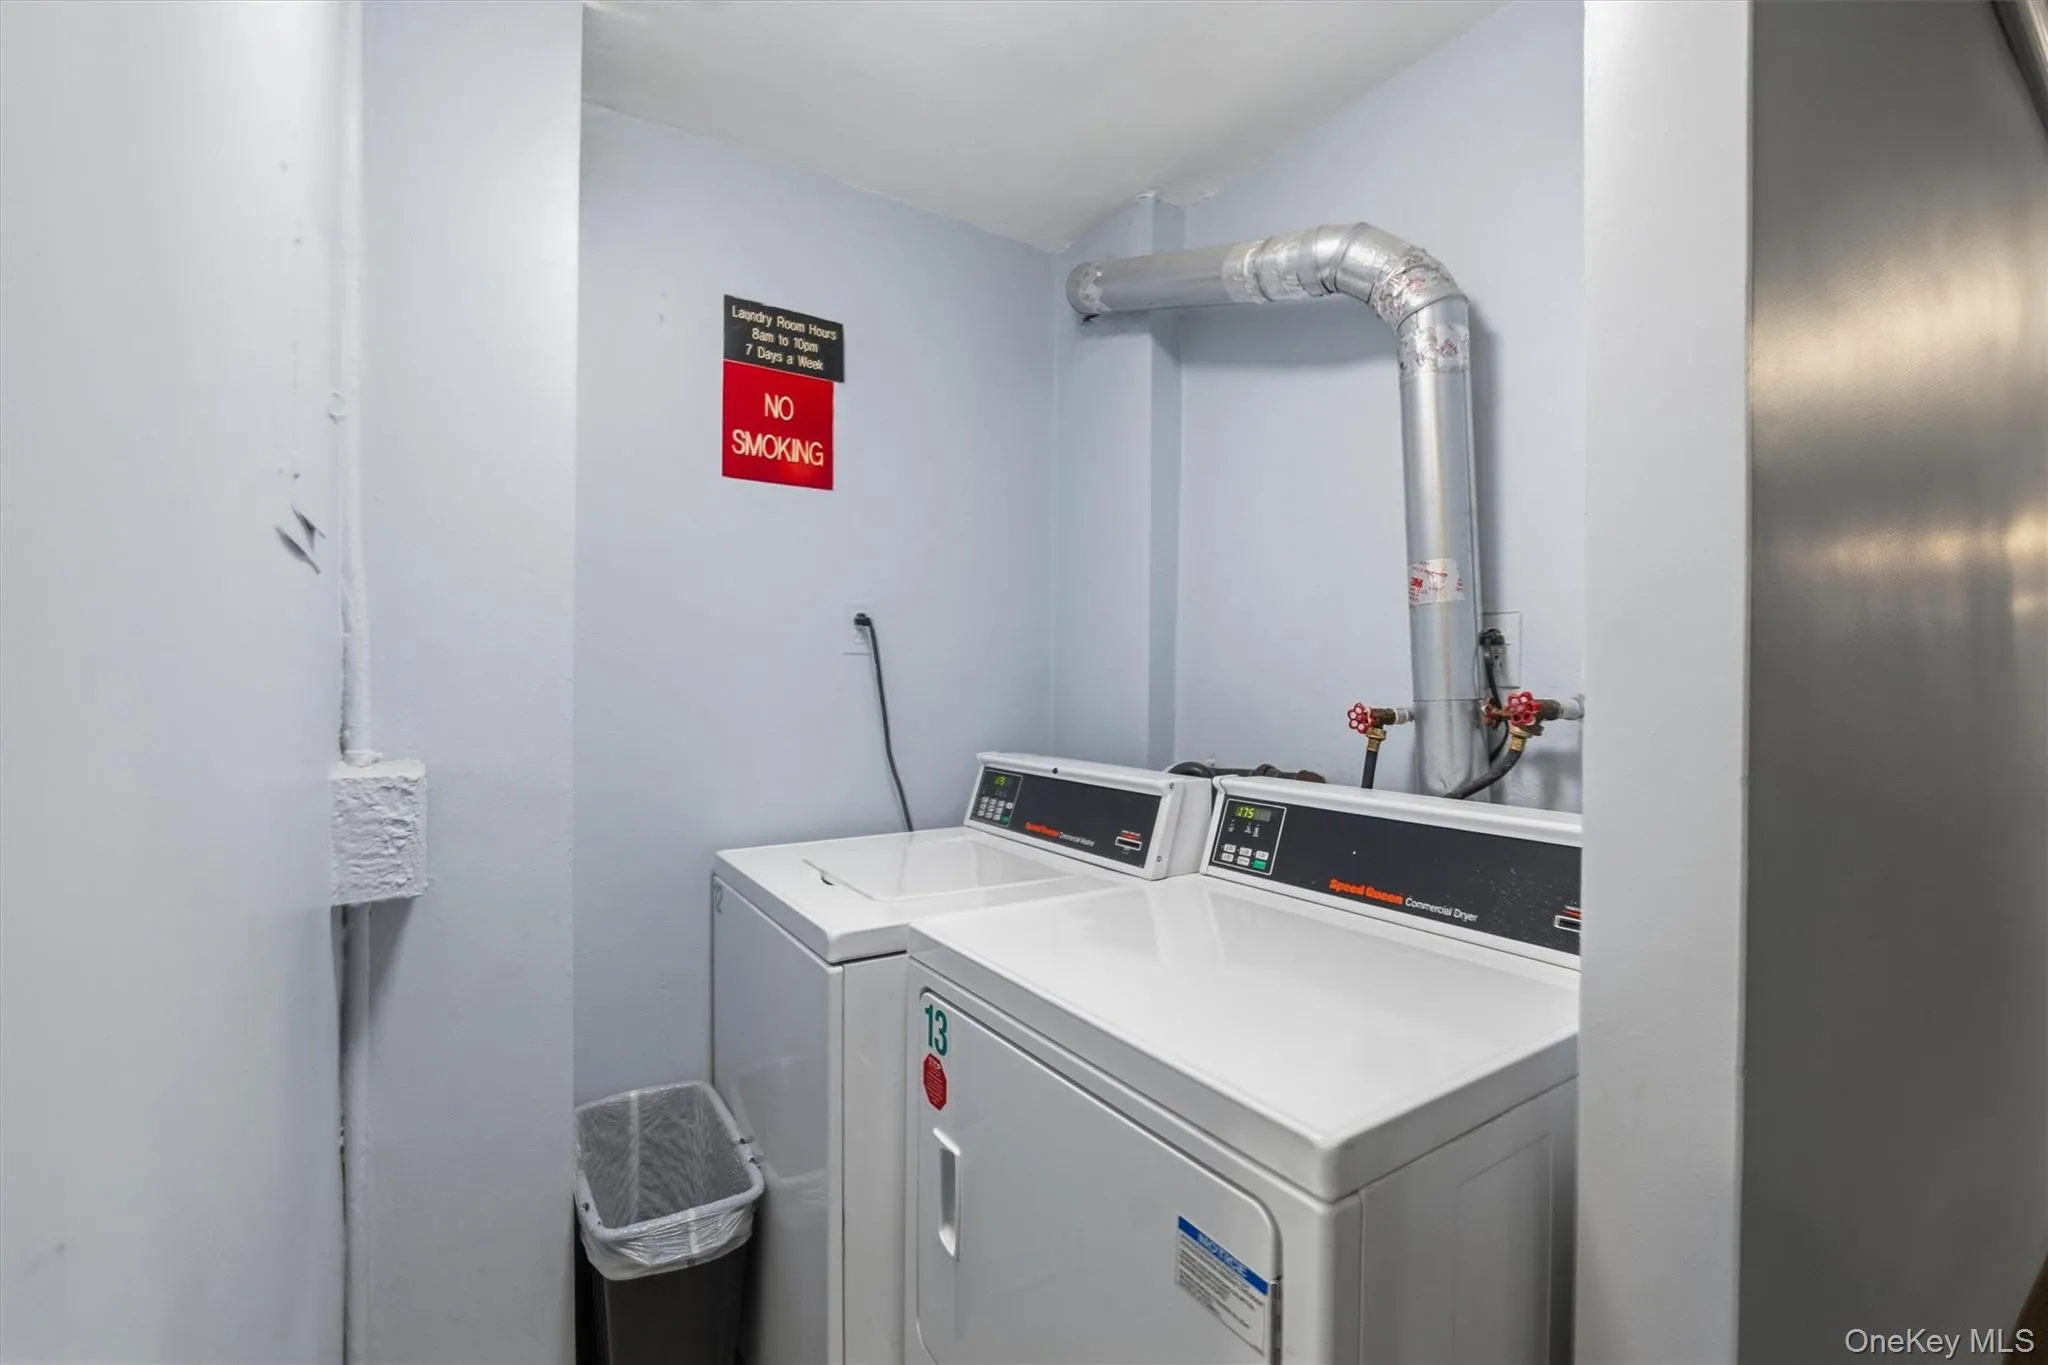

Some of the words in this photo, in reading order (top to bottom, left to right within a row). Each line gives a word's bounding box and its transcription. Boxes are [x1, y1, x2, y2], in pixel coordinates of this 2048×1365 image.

[732, 305, 772, 328] Laundry
[777, 316, 805, 333] Room
[809, 324, 837, 341] Hours
[752, 328, 774, 343] 8am
[778, 335, 789, 347] to
[794, 337, 818, 353] 10pm
[745, 343, 753, 355] 7
[757, 347, 783, 363] Days
[786, 354, 794, 365] a
[798, 355, 824, 371] Week
[764, 392, 794, 421] NO
[732, 429, 825, 467] SMOKING
[1328, 878, 1365, 896] Speed
[1365, 886, 1404, 905] Queen
[1405, 896, 1453, 916] Commercial
[1453, 908, 1479, 922] Dryer
[924, 1004, 948, 1056] 13
